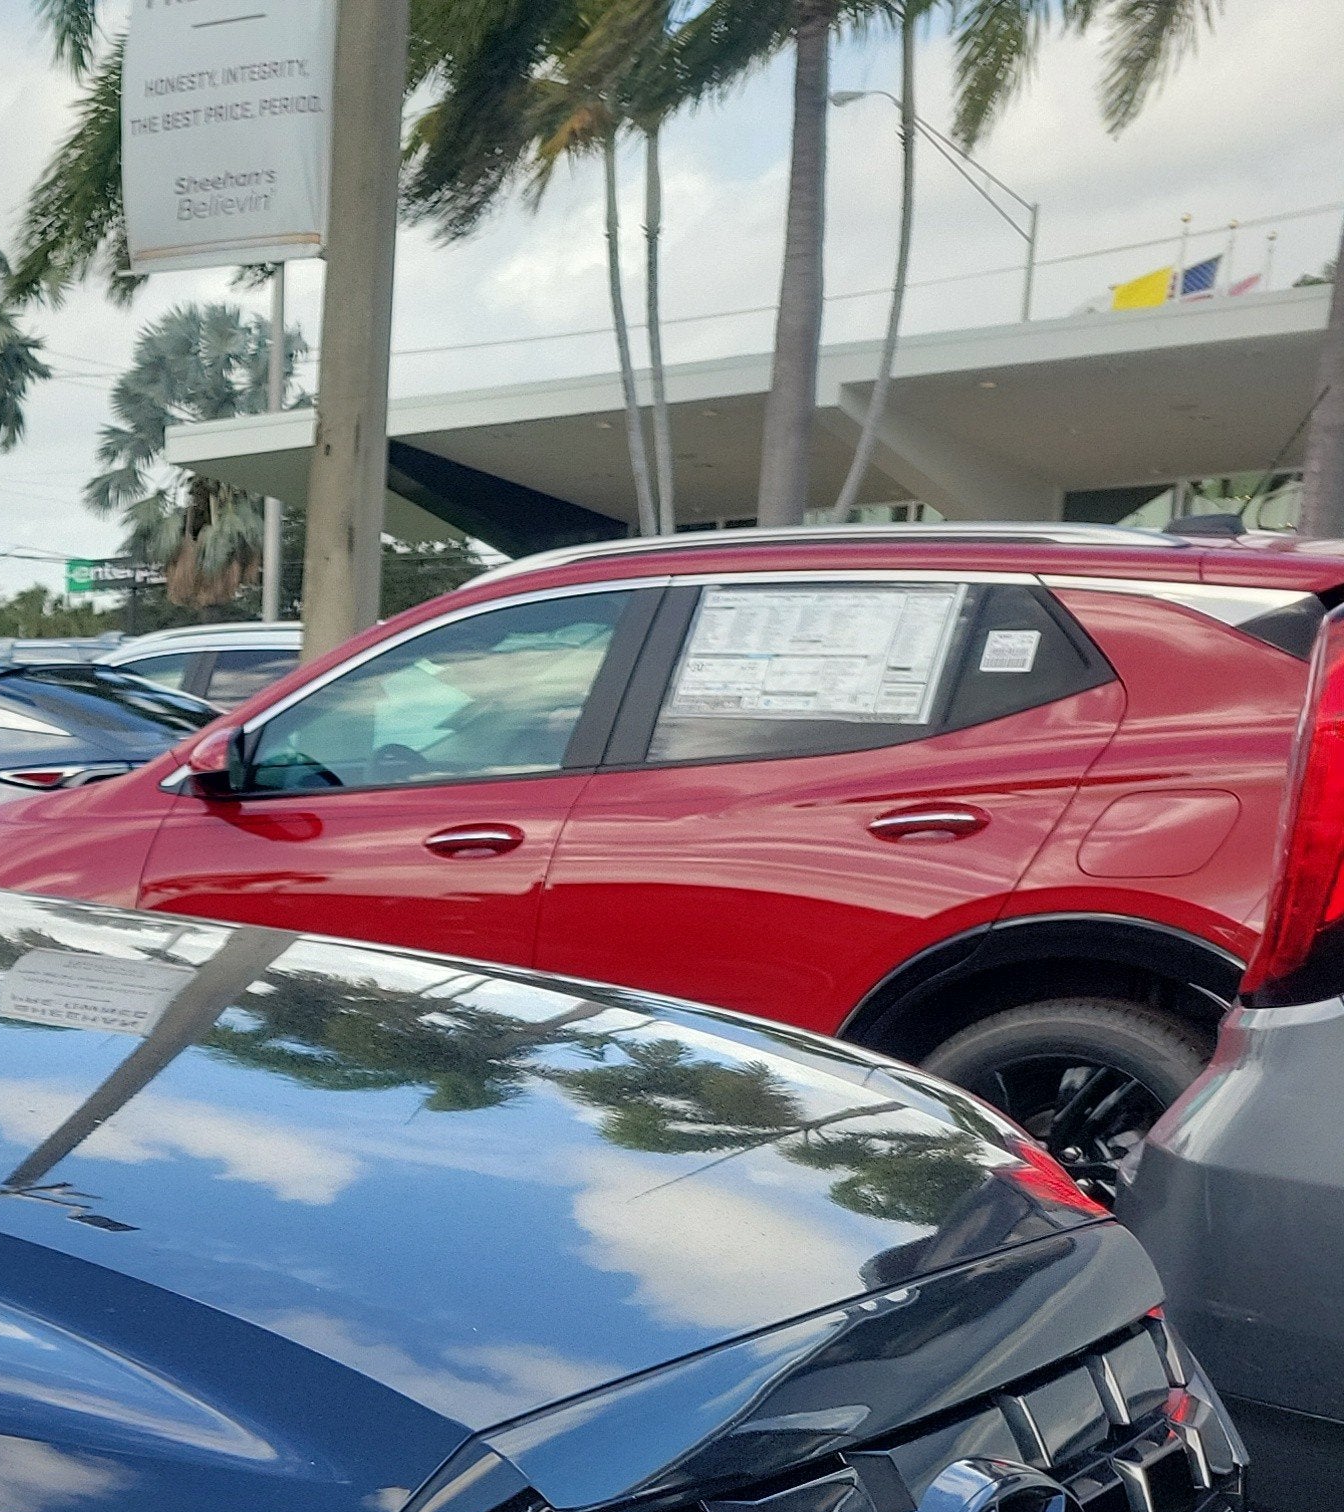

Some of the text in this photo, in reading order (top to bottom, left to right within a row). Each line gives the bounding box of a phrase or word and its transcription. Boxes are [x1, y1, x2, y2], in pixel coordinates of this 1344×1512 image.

[131, 116, 160, 136] THE
[162, 109, 202, 132] BEST
[173, 168, 278, 195] Sheehan's
